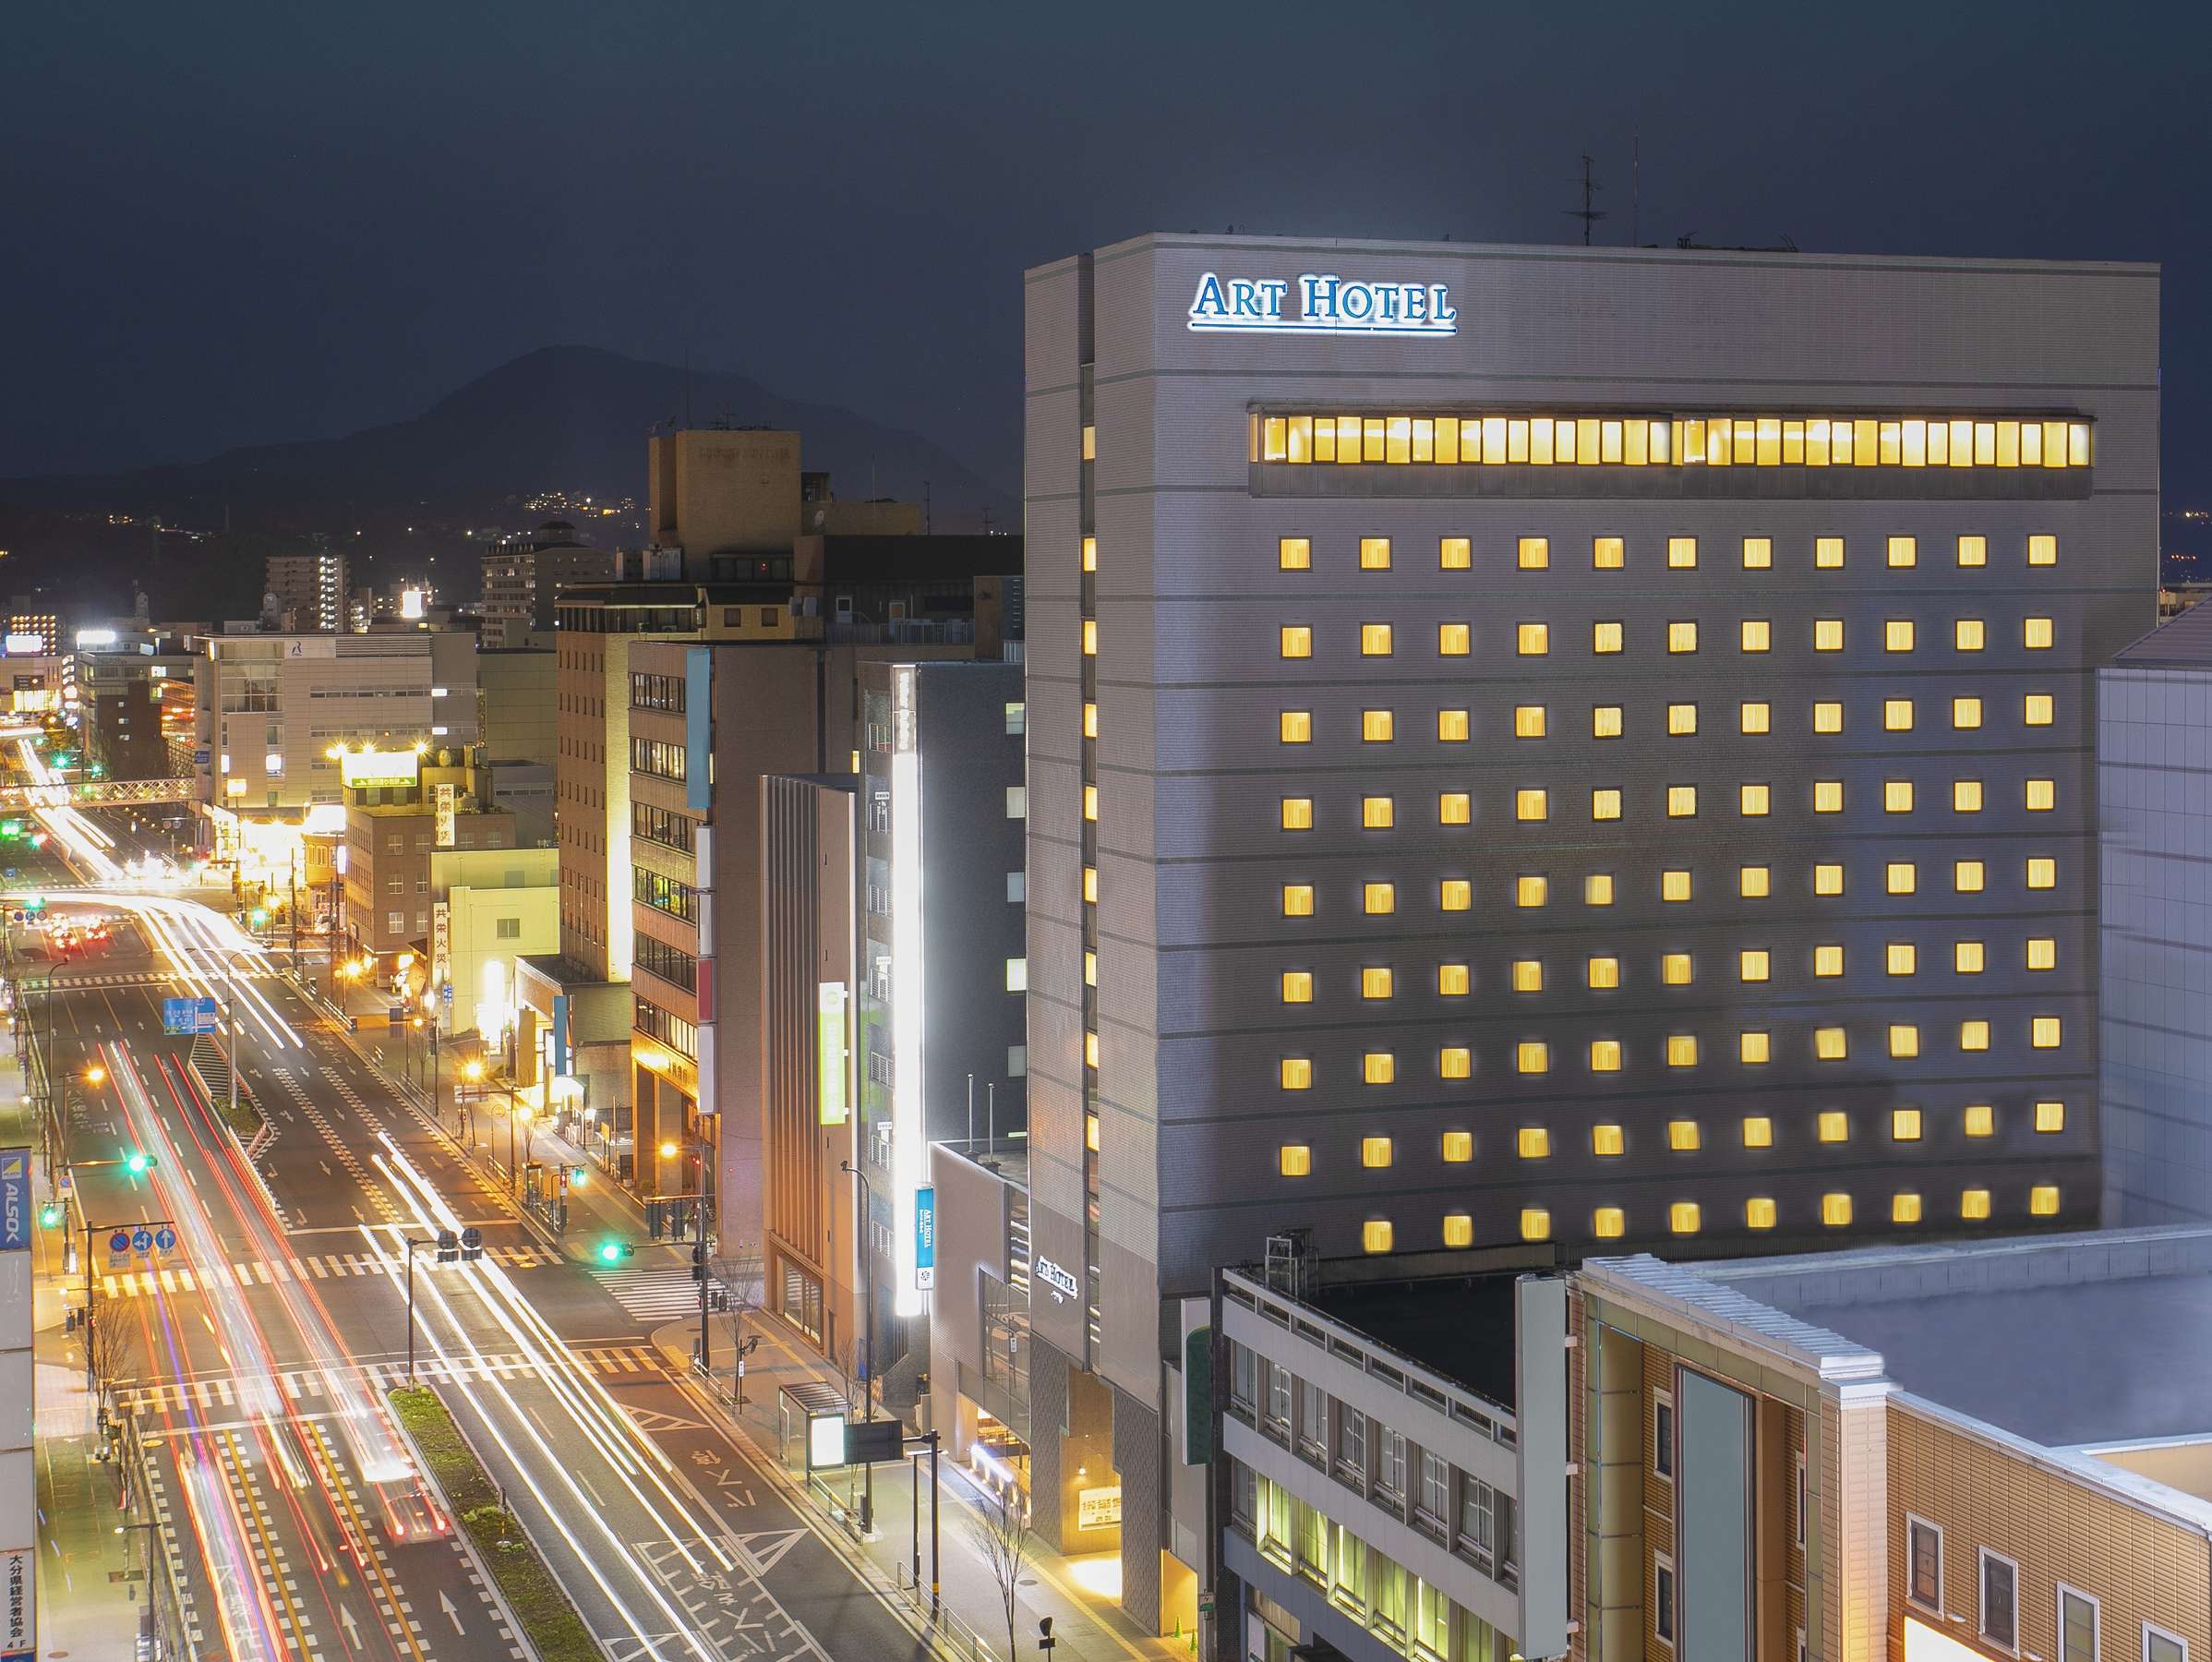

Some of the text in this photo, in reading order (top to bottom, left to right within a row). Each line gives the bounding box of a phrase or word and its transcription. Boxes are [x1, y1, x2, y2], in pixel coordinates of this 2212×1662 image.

[1193, 276, 1457, 320] ART HOTEL
[436, 908, 447, 964] 共栄火災
[6, 1182, 19, 1244] ALSOK
[9, 1554, 23, 1638] 大分県経営者協会
